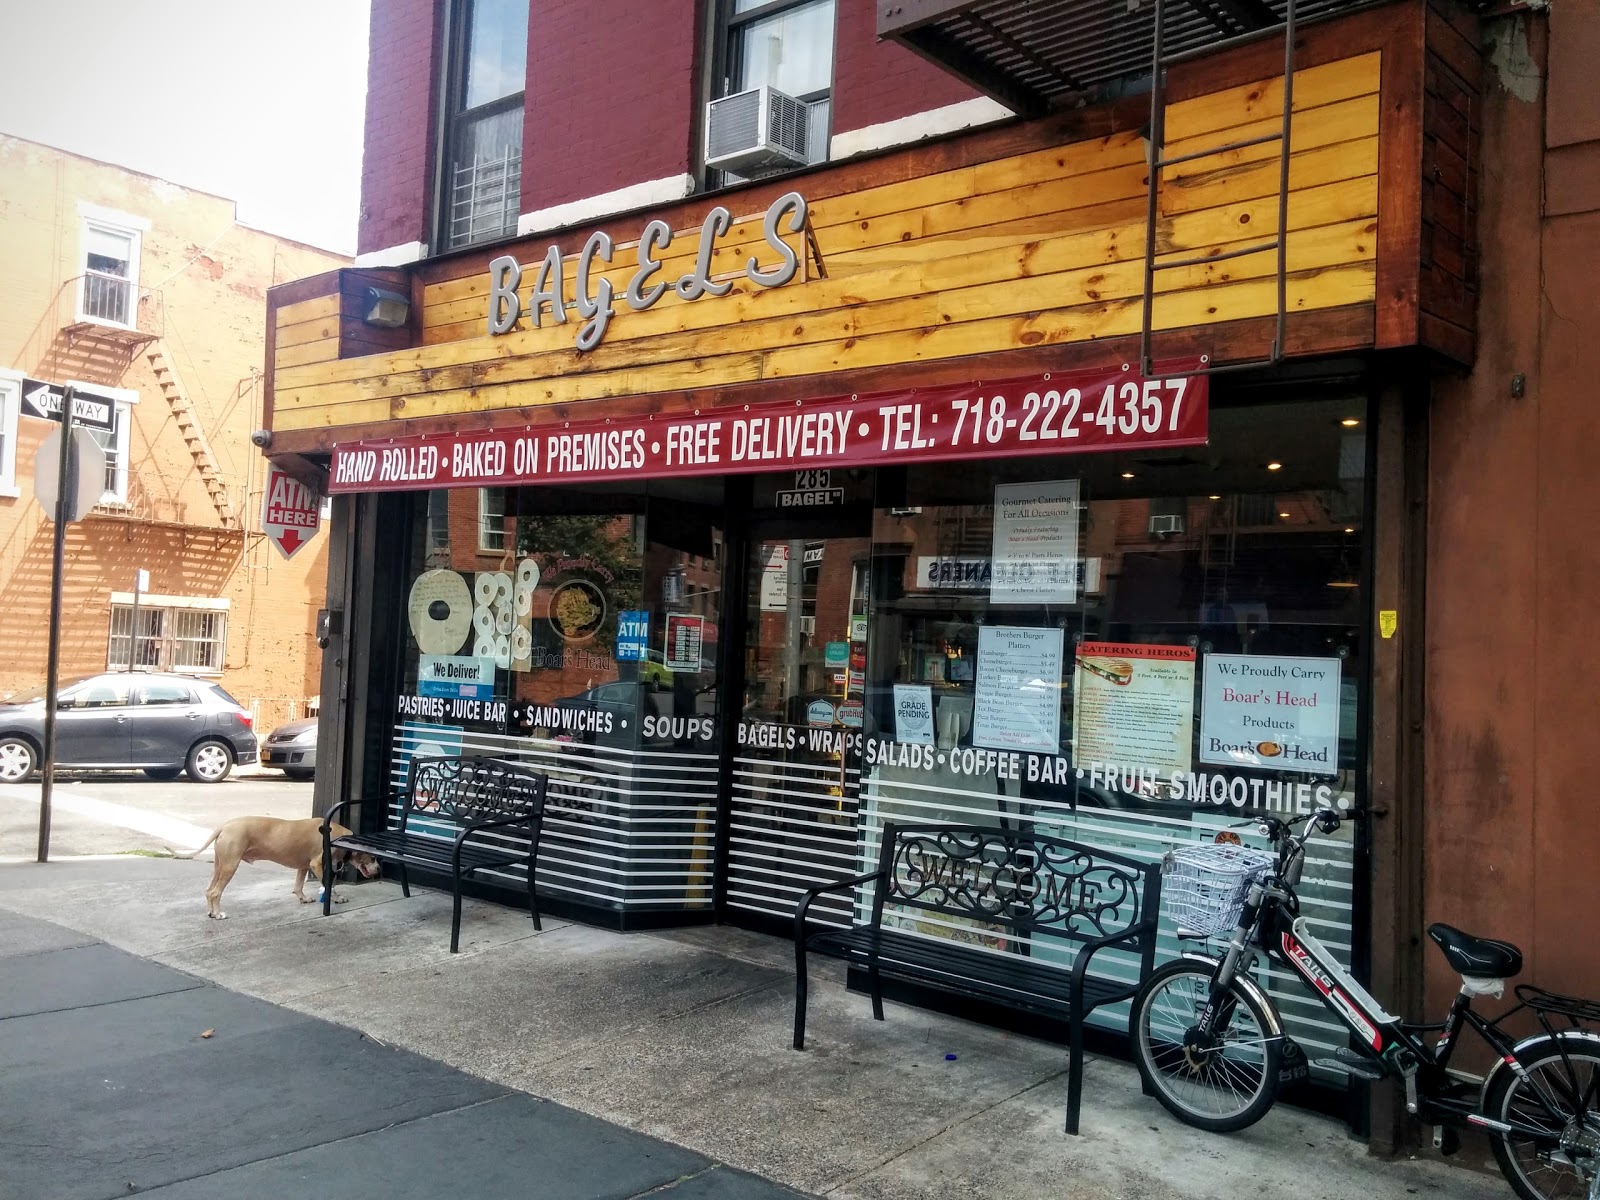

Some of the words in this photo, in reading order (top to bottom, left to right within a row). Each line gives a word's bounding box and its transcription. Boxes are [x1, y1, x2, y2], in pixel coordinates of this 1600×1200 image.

[488, 192, 807, 351] BAGELS
[75, 401, 103, 419] WAY
[336, 451, 375, 483] HAND
[379, 446, 438, 482] ROLLED
[452, 440, 505, 478] BAKED
[513, 438, 539, 475] ON
[546, 428, 646, 473] PREMISES
[666, 422, 722, 466] FREE
[731, 410, 854, 461] DELIVERY
[879, 403, 938, 451] TEL:
[950, 377, 1188, 446] 718-222-4357
[797, 470, 828, 488] 285
[782, 491, 834, 507] BAGEL
[1001, 497, 1036, 506] Gourmet
[1037, 495, 1071, 504] Catering
[269, 509, 317, 526] HERE
[1003, 510, 1016, 518] For
[1018, 509, 1029, 518] All
[1031, 508, 1069, 518] Occasions
[618, 622, 648, 637] ATM
[995, 630, 1022, 639] Brothers
[1023, 631, 1045, 640] Burger
[980, 649, 1008, 657] Hamburger
[1008, 641, 1031, 649] Platters
[1082, 646, 1143, 655] CATERING
[1147, 649, 1191, 657] HEROS
[433, 662, 446, 677] We
[447, 662, 481, 680] Deliver!
[1218, 663, 1238, 675] We
[1241, 664, 1288, 680] Proudly
[1291, 666, 1326, 681] Carry
[901, 701, 926, 710] GRADE
[1223, 687, 1271, 704] Boar's
[1276, 690, 1317, 708] Head
[398, 695, 444, 718] PASTRIES
[451, 700, 480, 720] JUICE
[484, 701, 507, 722] BAR
[526, 705, 613, 734] SANDWICHES
[642, 716, 714, 742] SOUPS
[897, 709, 930, 719] PENDING
[1243, 715, 1295, 730] Products
[1209, 738, 1255, 755] Boar's
[1282, 743, 1328, 763] Head
[737, 722, 796, 750] BAGELS
[808, 729, 862, 757] WRAPS
[865, 738, 934, 771] SALADS
[950, 750, 1019, 781] COFFEE
[1027, 757, 1068, 785] BAR
[1090, 763, 1161, 797] FRUIT
[1170, 770, 1334, 815] SMOOTHIES
[428, 777, 516, 810] WELCOME
[921, 853, 1103, 912] WELCOME
[1295, 945, 1335, 988] TAILG
[1198, 1004, 1214, 1032] TAILG
